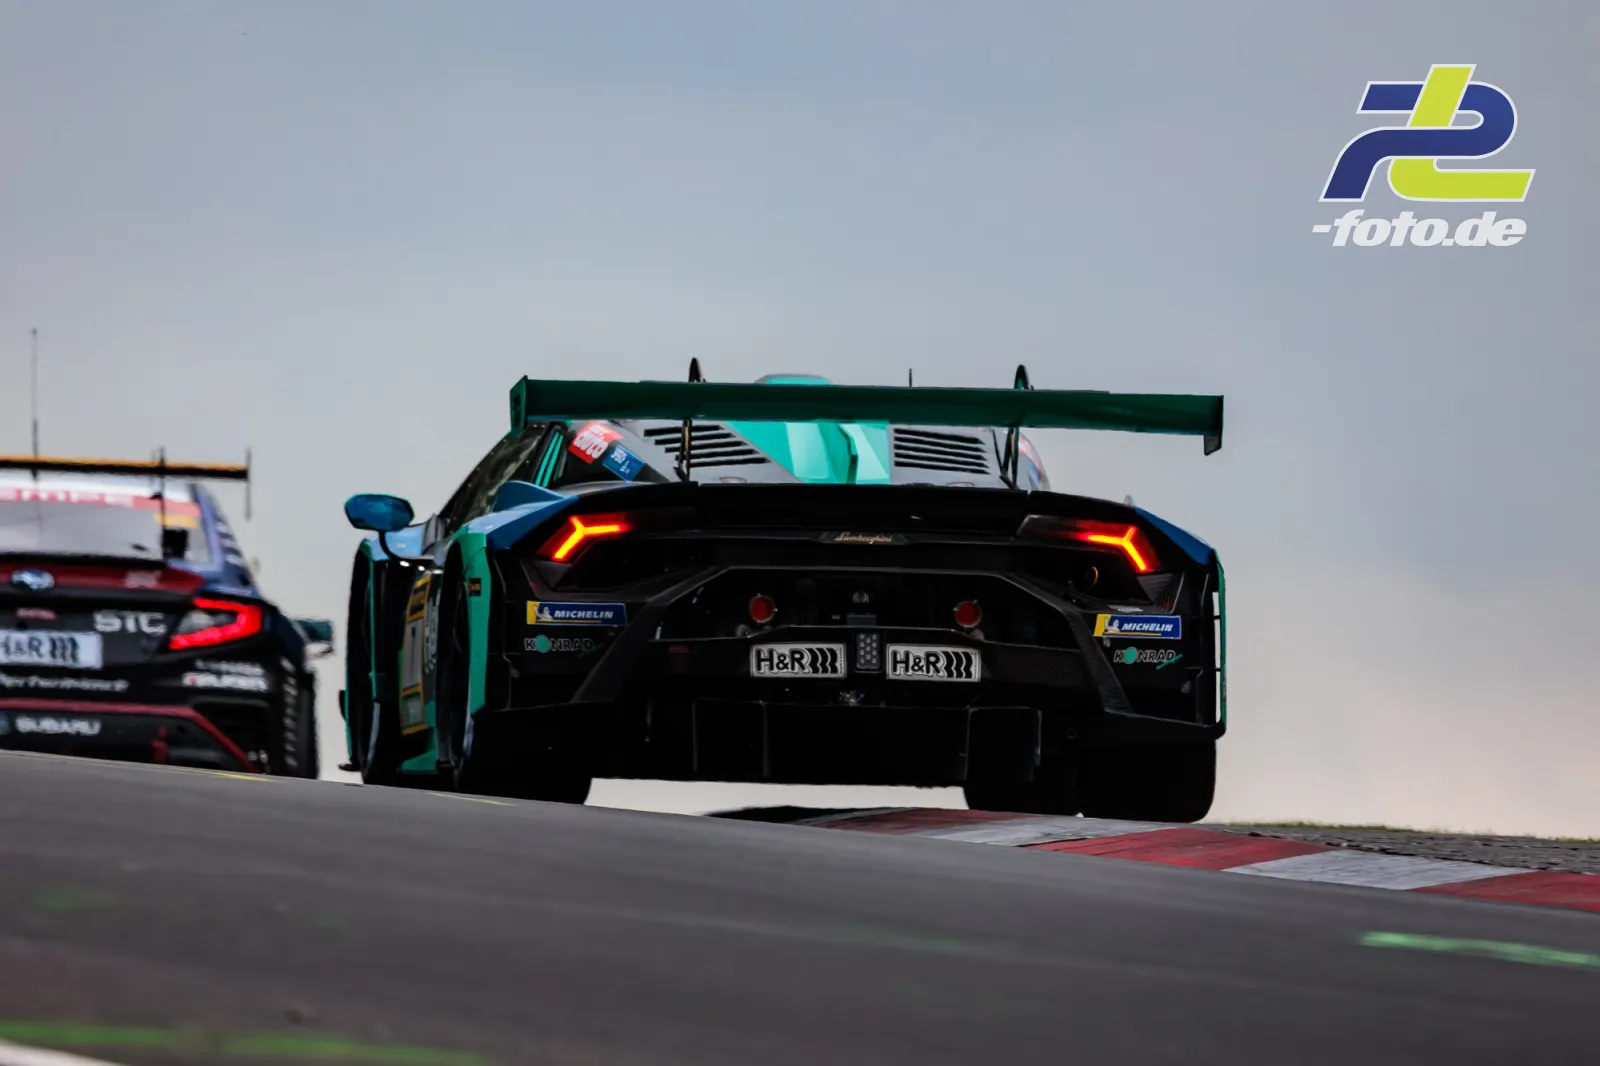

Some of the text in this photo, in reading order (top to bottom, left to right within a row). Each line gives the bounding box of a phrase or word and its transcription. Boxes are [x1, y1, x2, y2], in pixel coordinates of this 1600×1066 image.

[554, 610, 614, 619] MICHELIN
[1121, 623, 1174, 632] MICHELIN
[524, 635, 595, 653] KONRAD
[755, 647, 809, 676] H&R
[891, 649, 945, 678] H&R
[1113, 647, 1177, 664] KONRAD
[16, 716, 101, 736] SUBARU
